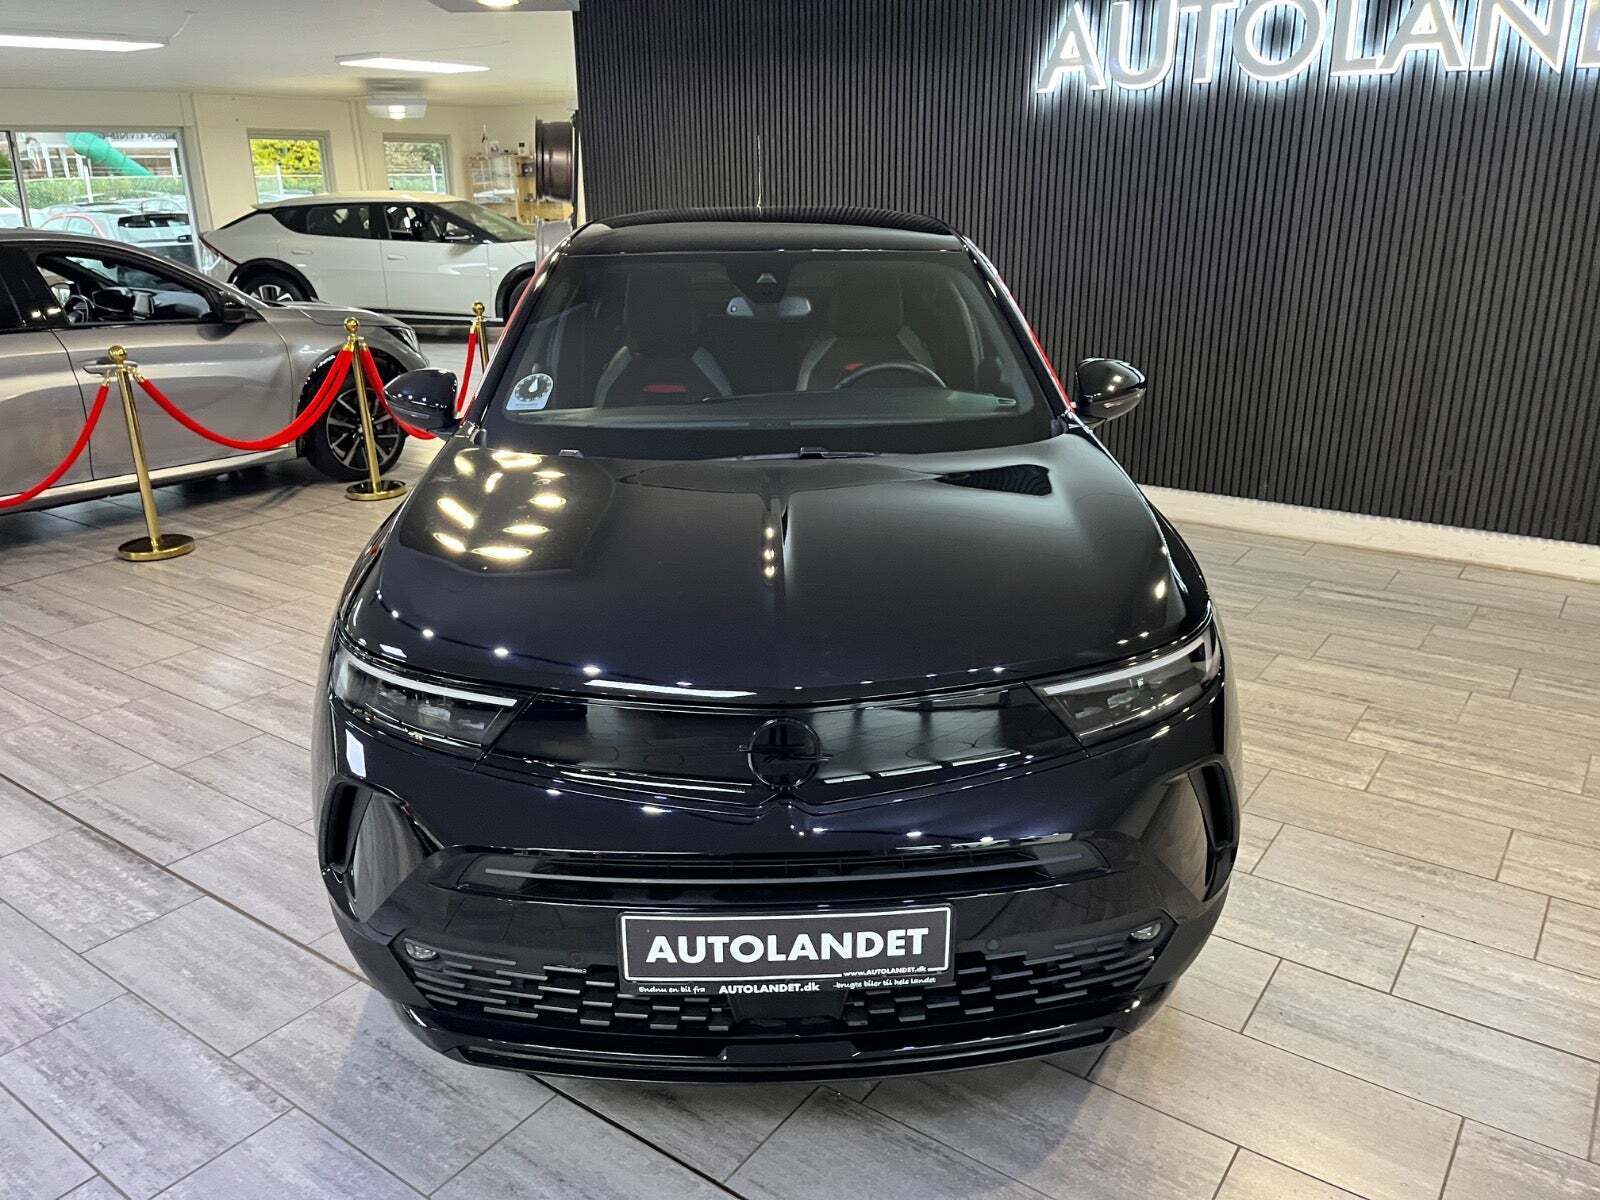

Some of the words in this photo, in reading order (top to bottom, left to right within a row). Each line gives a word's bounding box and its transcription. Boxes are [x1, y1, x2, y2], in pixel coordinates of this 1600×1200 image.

[645, 927, 929, 964] AUTOLANDET
[843, 965, 927, 977] www.AUTOLANDET.dk
[863, 979, 882, 987] biler
[882, 978, 893, 986] til
[894, 977, 909, 985] hele
[680, 985, 691, 993] bil
[692, 985, 706, 995] fra
[718, 982, 821, 995] AUTOLANDET.dk
